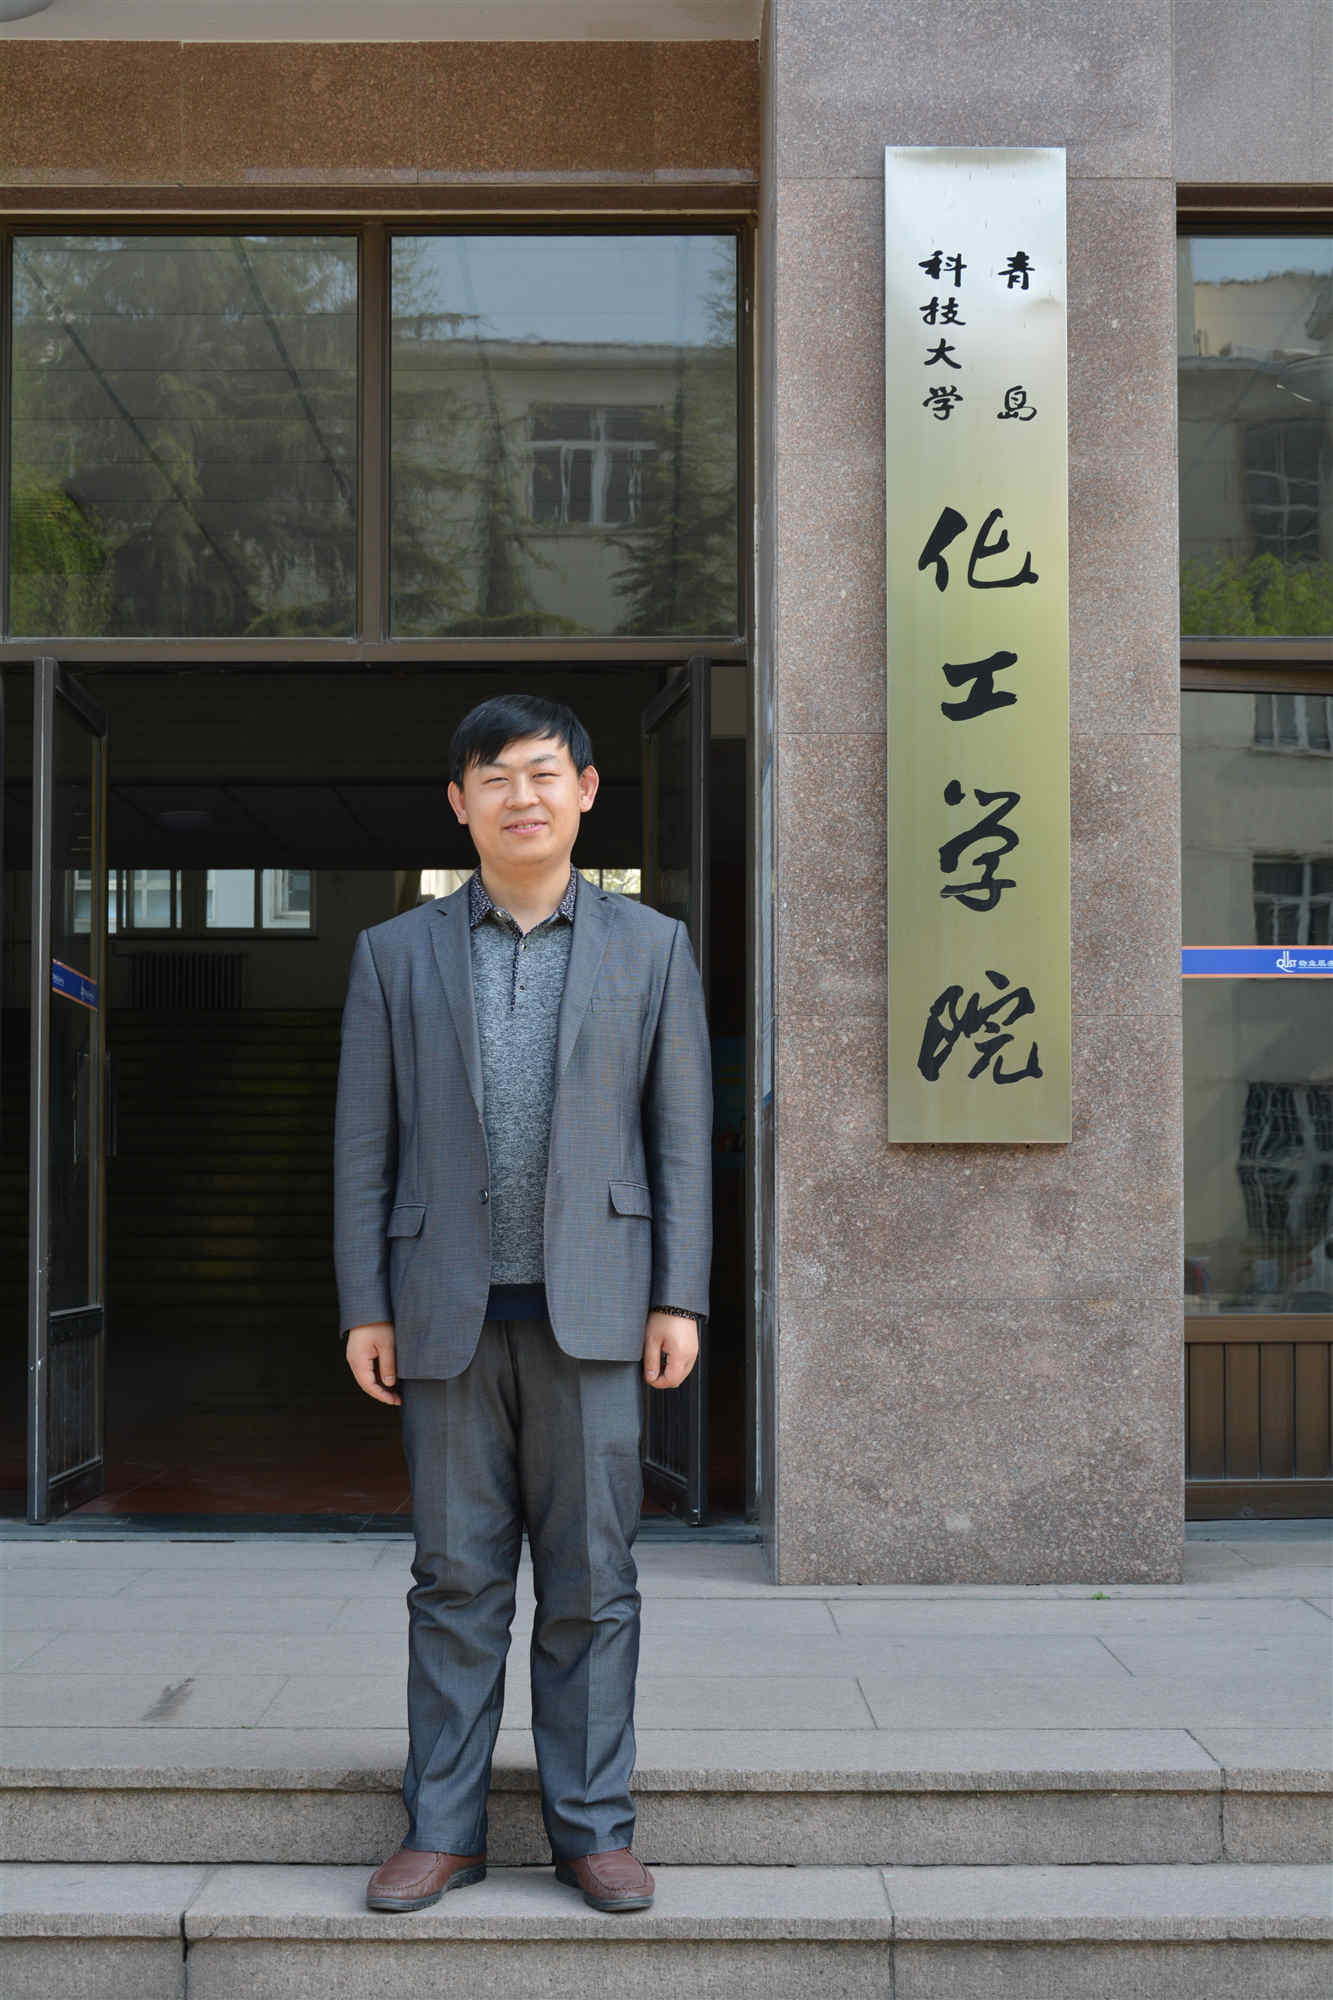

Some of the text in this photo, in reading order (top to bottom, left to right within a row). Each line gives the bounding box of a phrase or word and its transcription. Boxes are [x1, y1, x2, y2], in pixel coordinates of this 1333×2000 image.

[918, 250, 967, 421] 科技大学
[998, 251, 1037, 421] 青岛
[917, 506, 1044, 1085] 化工学院
